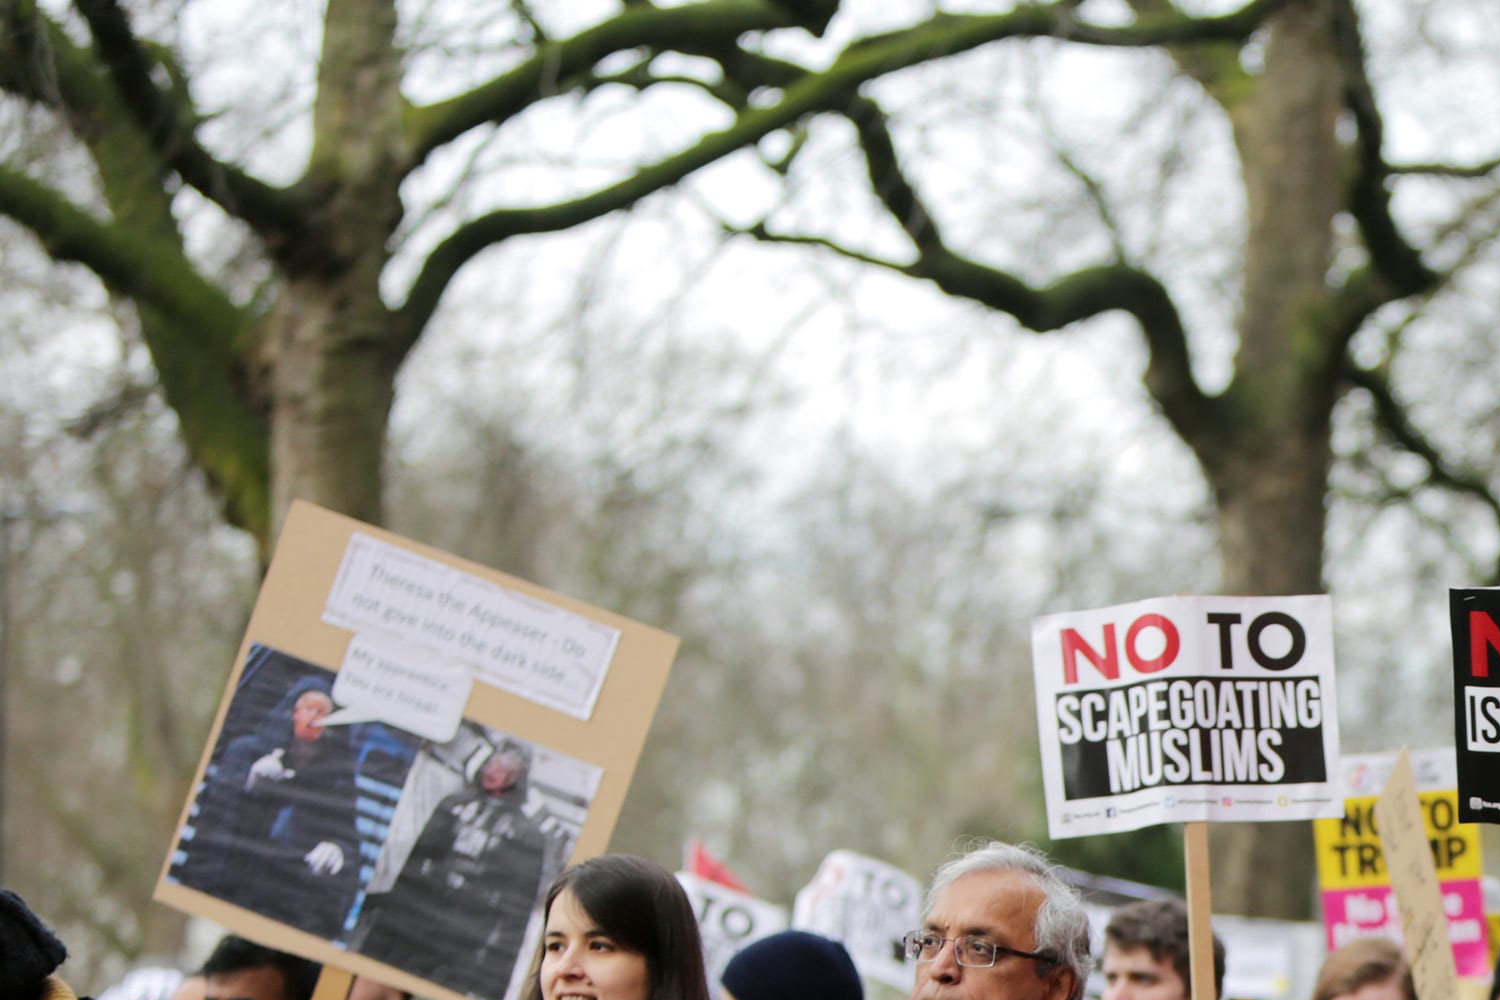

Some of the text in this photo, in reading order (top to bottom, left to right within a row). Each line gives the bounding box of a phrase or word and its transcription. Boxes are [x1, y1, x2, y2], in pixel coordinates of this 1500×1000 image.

[352, 592, 380, 616] not
[383, 606, 417, 630] give
[421, 615, 456, 643] into
[459, 631, 488, 653] the
[492, 641, 527, 668] dark
[369, 564, 435, 600] Theresa
[438, 591, 467, 615] the
[467, 604, 548, 645] Appeaser
[560, 635, 586, 658] Do
[1060, 611, 1307, 685] NO TO
[1056, 679, 1323, 744] SCAPEGOATING
[1106, 728, 1286, 793] MUSLIMS
[1333, 837, 1467, 876] TRMP
